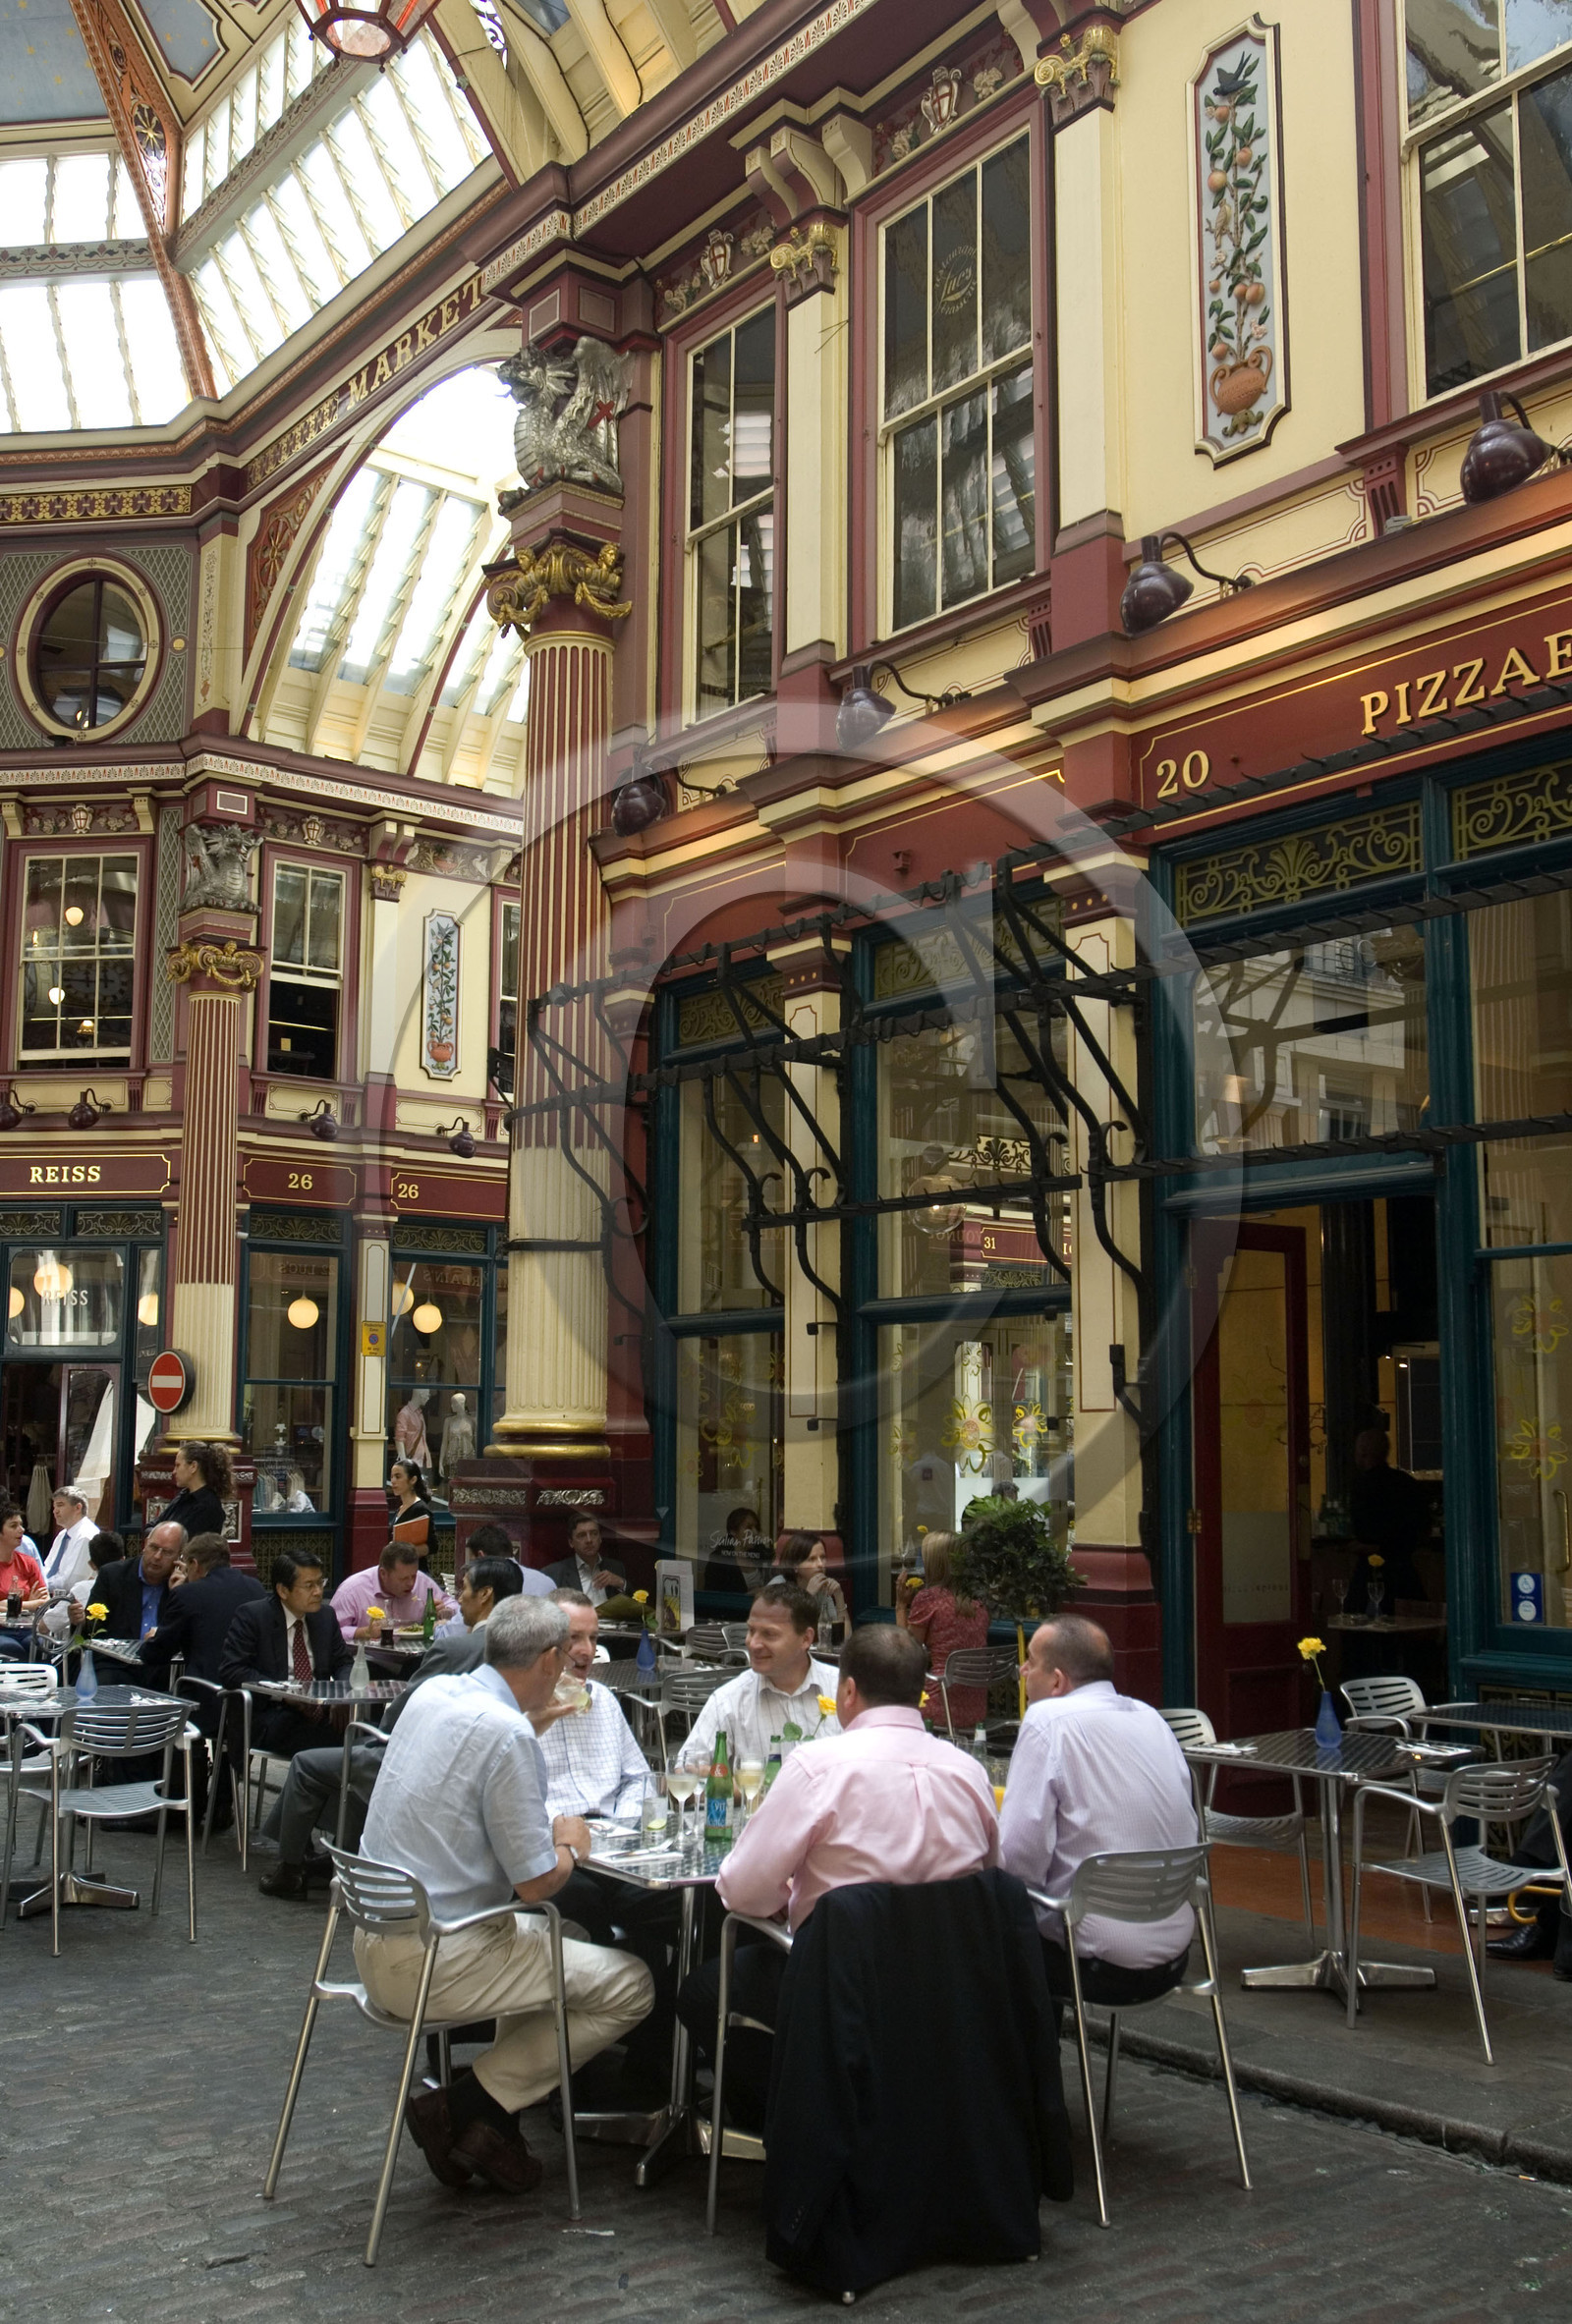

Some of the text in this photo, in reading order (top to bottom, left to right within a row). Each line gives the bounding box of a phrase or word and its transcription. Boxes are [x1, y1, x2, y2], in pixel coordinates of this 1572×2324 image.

[347, 273, 482, 411] MARKET
[1360, 629, 1572, 736] PIZZAE
[1156, 749, 1209, 799] 20
[29, 1166, 100, 1183] REISS
[288, 1173, 313, 1190] 26
[398, 1183, 420, 1198] 26
[983, 1236, 996, 1249] 31
[42, 1290, 88, 1306] REISS
[742, 1528, 773, 1547] Passion
